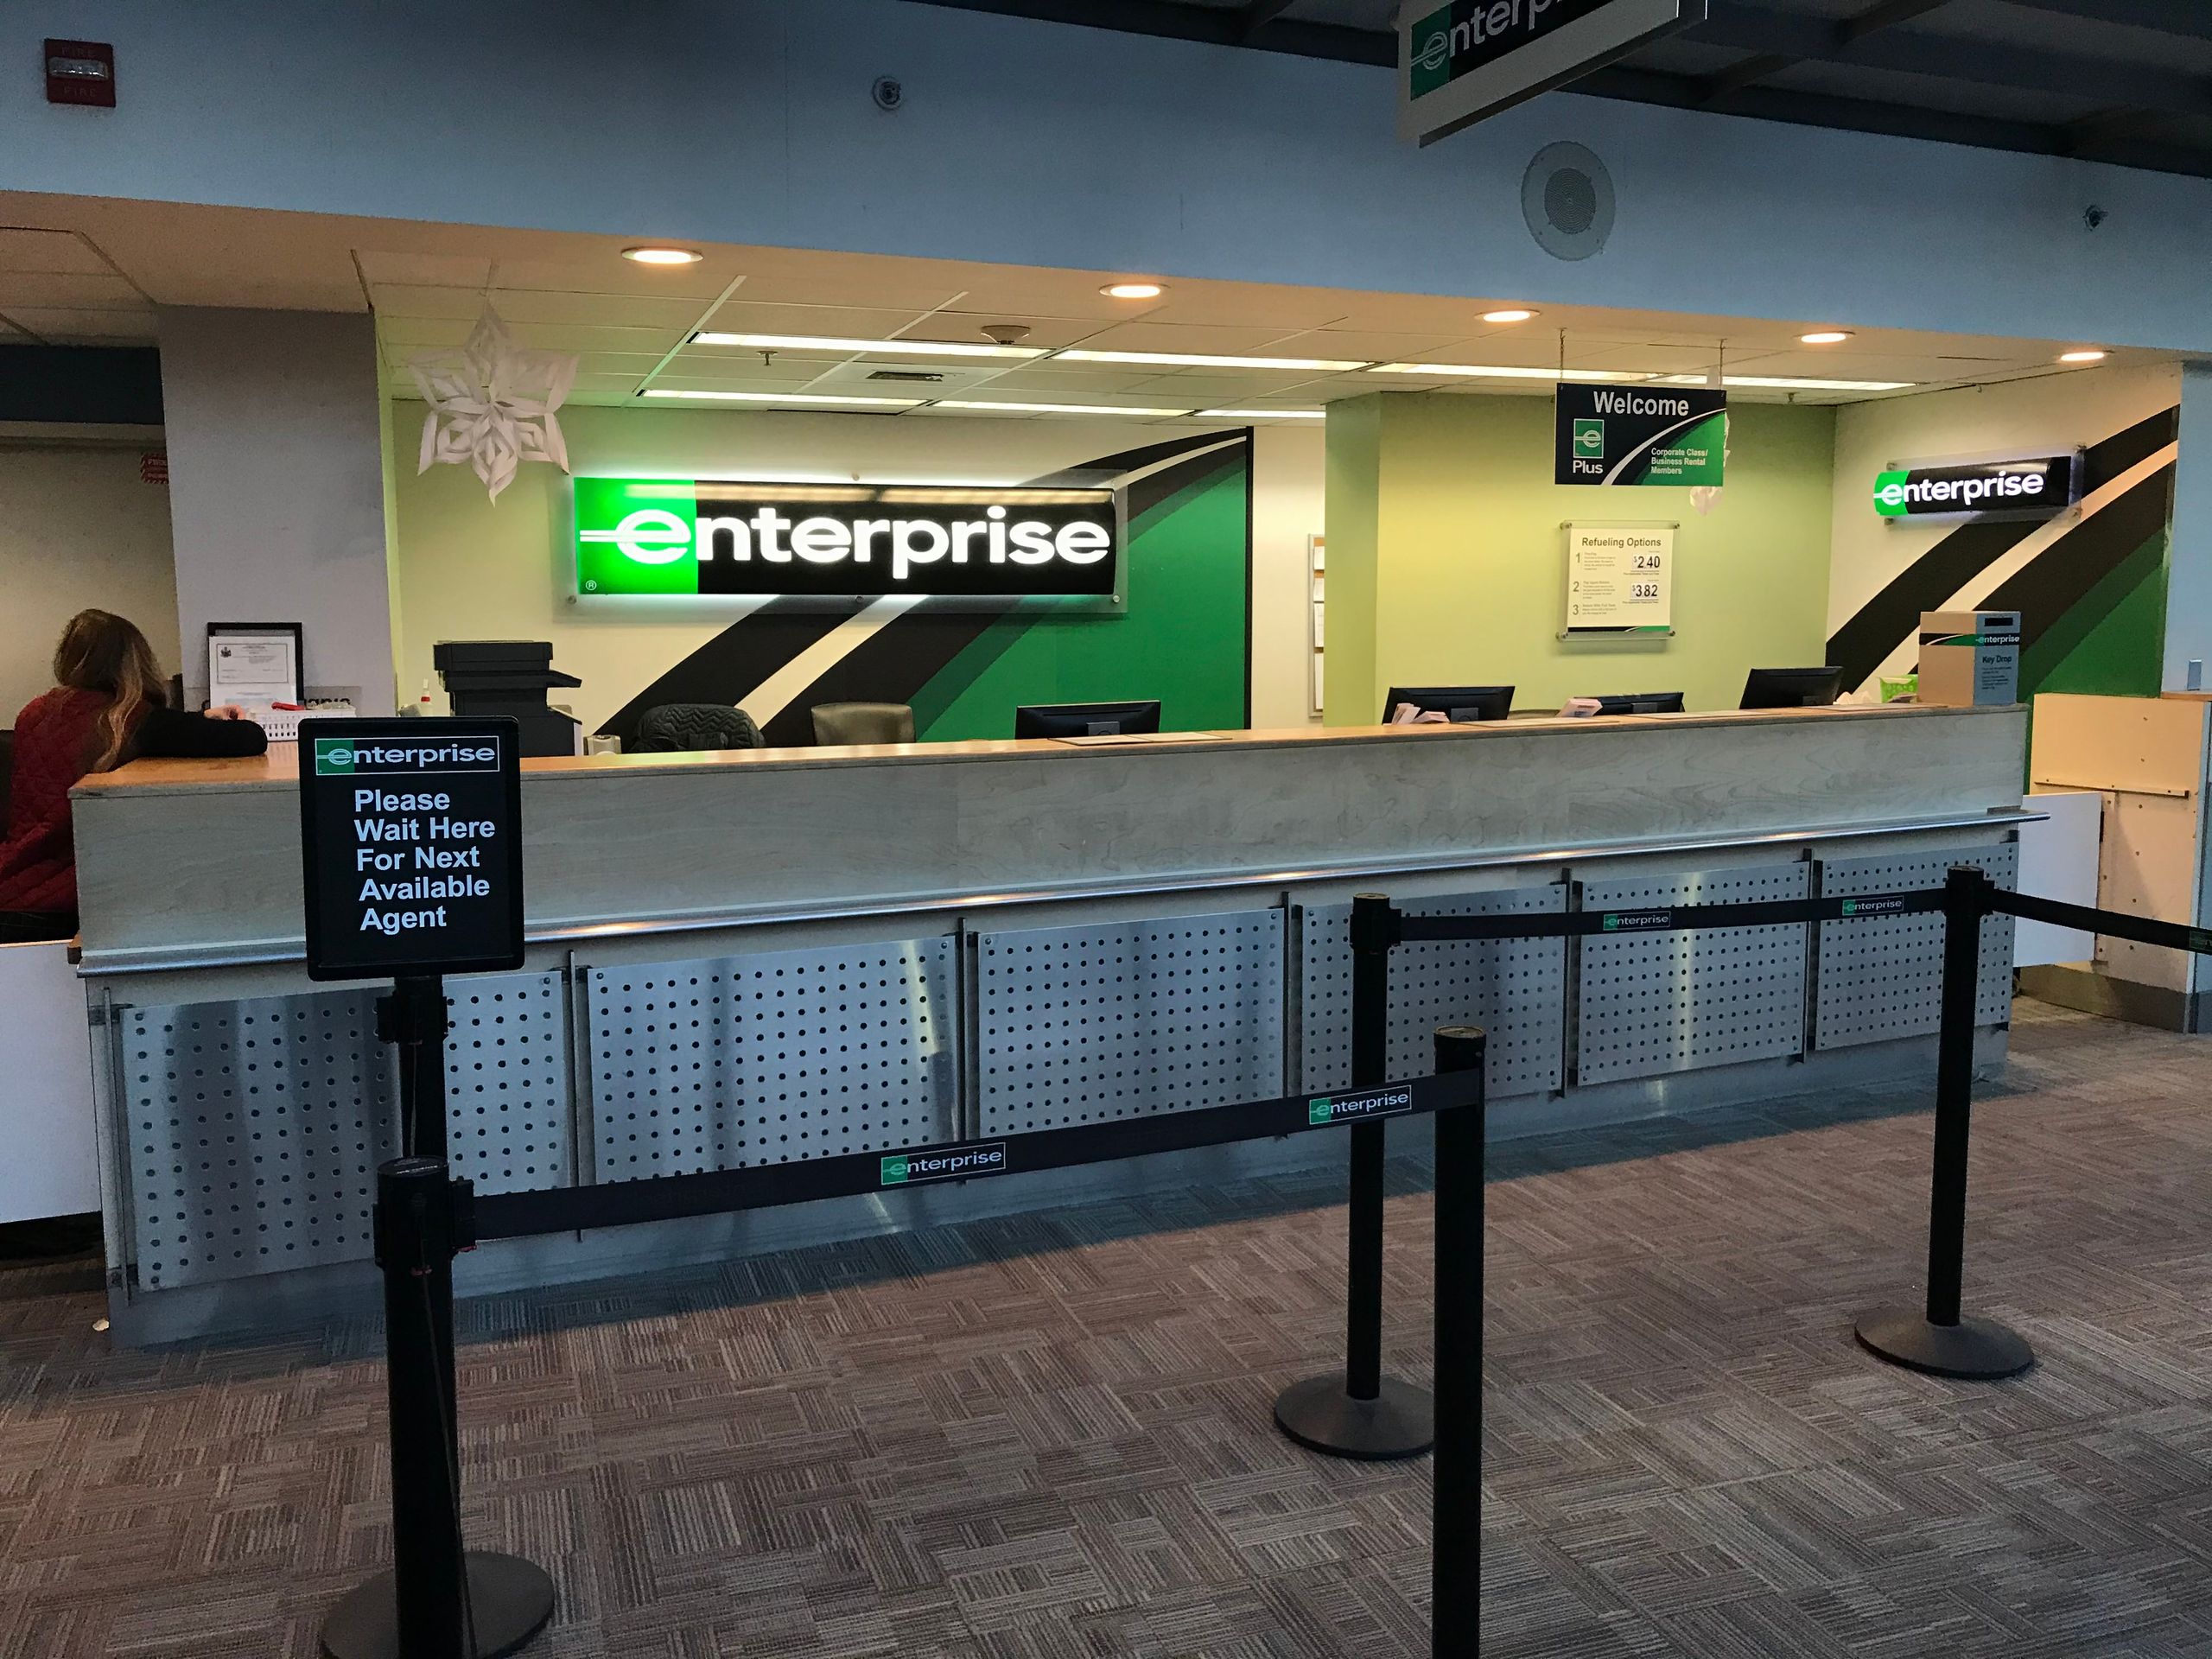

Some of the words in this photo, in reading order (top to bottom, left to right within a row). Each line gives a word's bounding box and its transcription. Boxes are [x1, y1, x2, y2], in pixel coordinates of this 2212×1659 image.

[1410, 0, 1560, 70] enterp
[61, 47, 96, 58] FIRE
[64, 86, 97, 98] FIRE
[1593, 391, 1689, 416] Welcome
[1651, 447, 1685, 457] Corporate
[1687, 448, 1709, 457] Class/
[1572, 460, 1604, 474] Plus
[1651, 466, 1682, 474] Members
[1873, 470, 2044, 505] enterprise
[580, 505, 1110, 580] enterprise
[1581, 537, 1624, 548] Refueling
[1626, 537, 1662, 548] Options
[1575, 553, 1581, 563] 1
[1573, 581, 1580, 592] 2
[1572, 604, 1579, 615] 3
[1975, 634, 2020, 644] enterprise
[1982, 656, 1995, 664] Key
[1996, 655, 2012, 664] Drop
[317, 743, 495, 767] enterprise
[354, 789, 450, 812] Please
[354, 817, 420, 842] Wait
[429, 817, 495, 839] Here
[356, 849, 405, 871] For
[415, 846, 480, 869] Next
[359, 874, 490, 901] Available
[1845, 899, 1902, 912] enterprise
[360, 906, 447, 935] Agent
[1605, 914, 1669, 926] enterprise
[1311, 1093, 1408, 1117] enterprise
[883, 1151, 1002, 1176] enterprise
